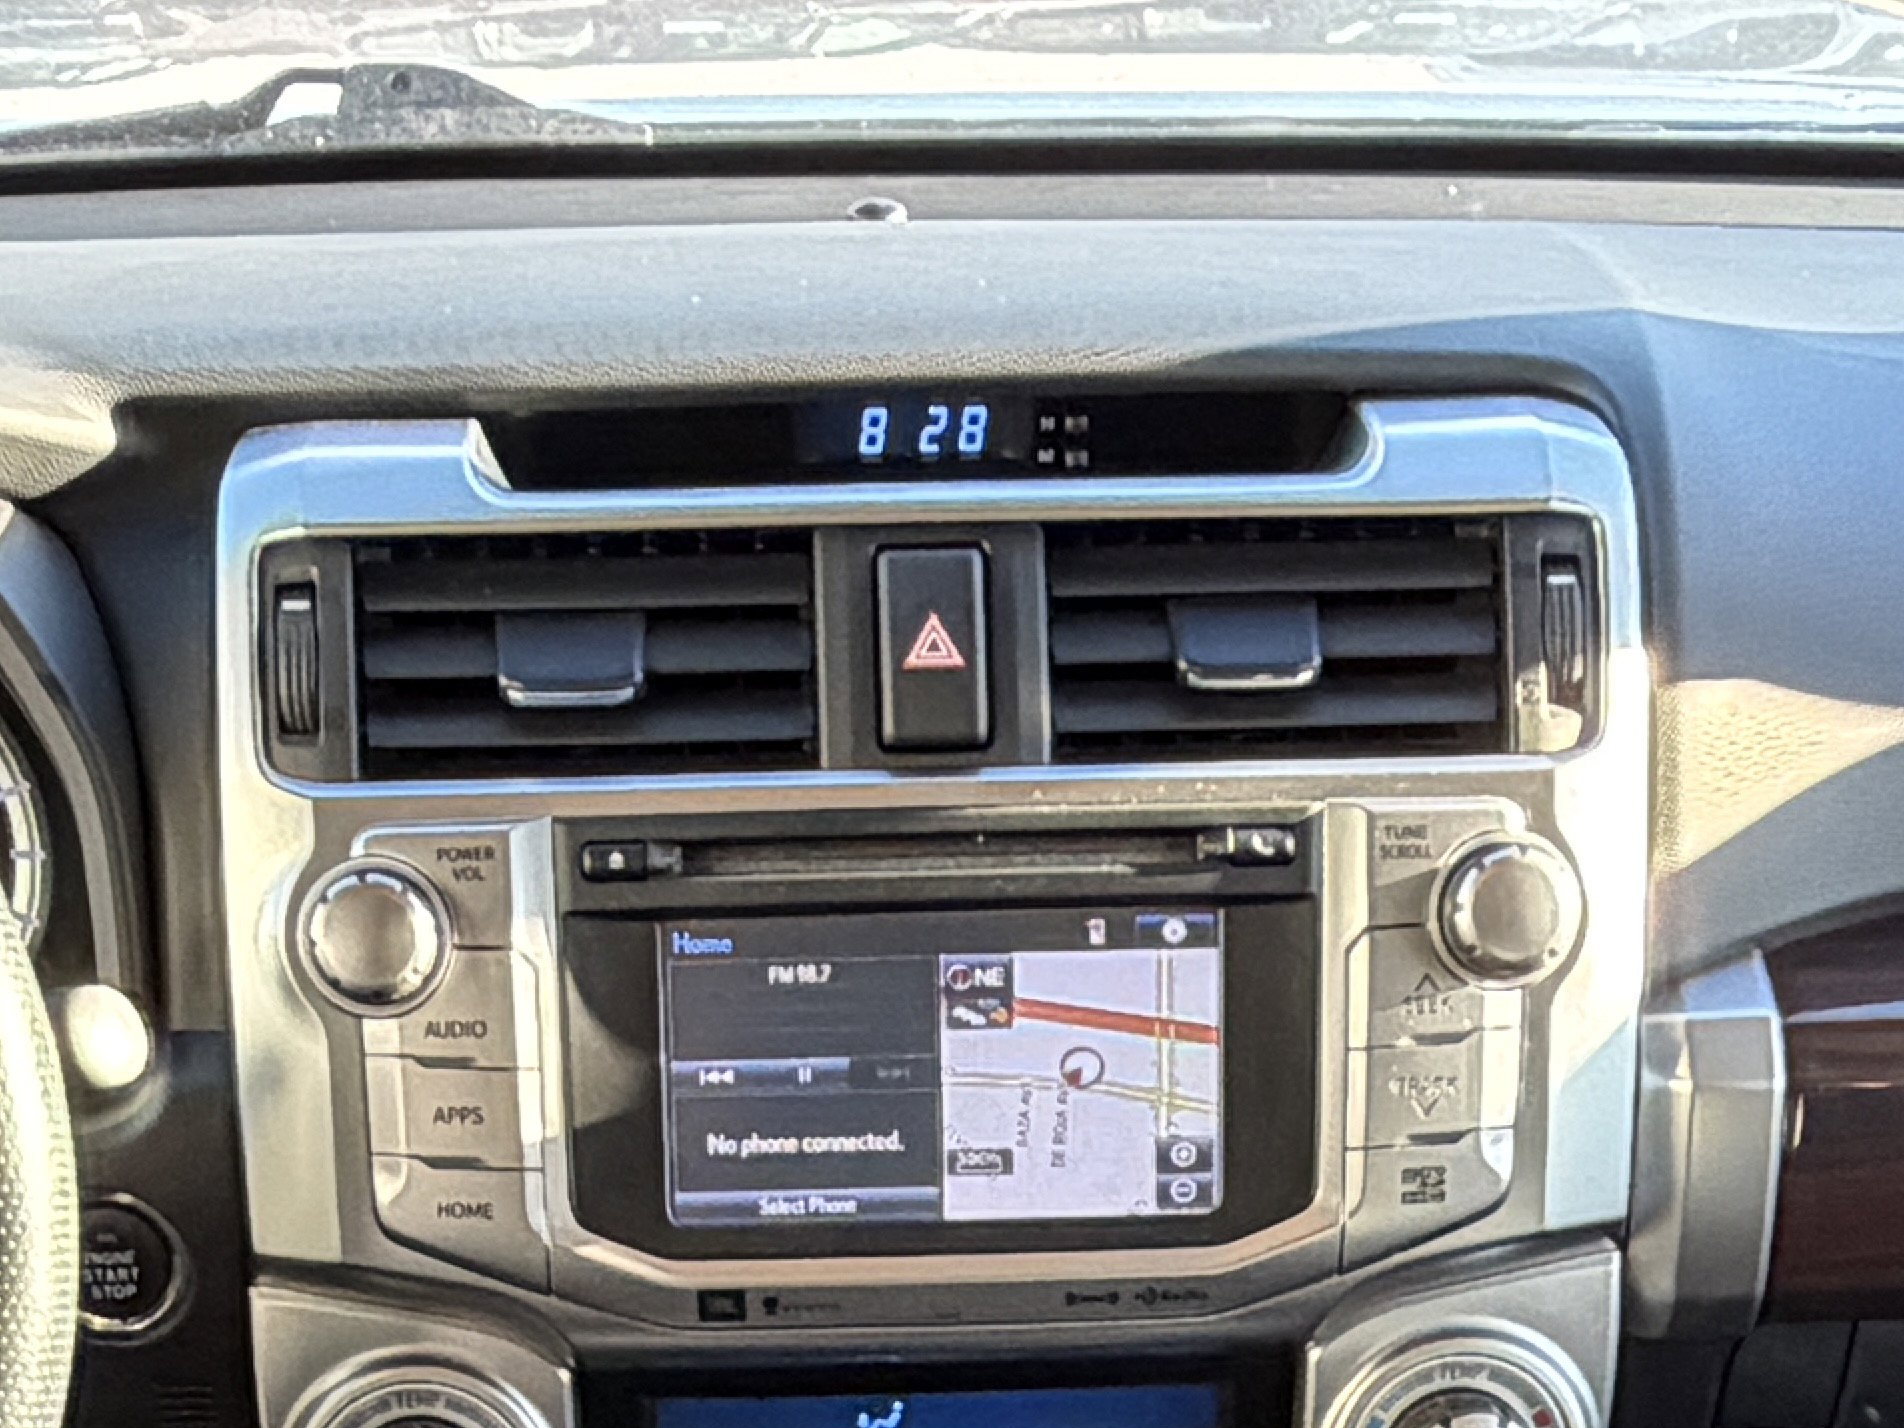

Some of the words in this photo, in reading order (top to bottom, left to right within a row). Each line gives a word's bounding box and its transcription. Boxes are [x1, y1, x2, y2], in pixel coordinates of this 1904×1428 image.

[918, 404, 989, 455] 28
[436, 846, 495, 864] POWER
[451, 865, 485, 883] VOL
[672, 931, 734, 954] Home
[423, 1019, 487, 1040] AUDIO
[432, 1105, 485, 1126] APPS
[706, 1132, 737, 1157] No
[740, 1131, 798, 1159] phone
[802, 1128, 906, 1154] connected.
[436, 1202, 494, 1221] HOME
[759, 1195, 806, 1216] Select
[808, 1195, 858, 1214] Phone
